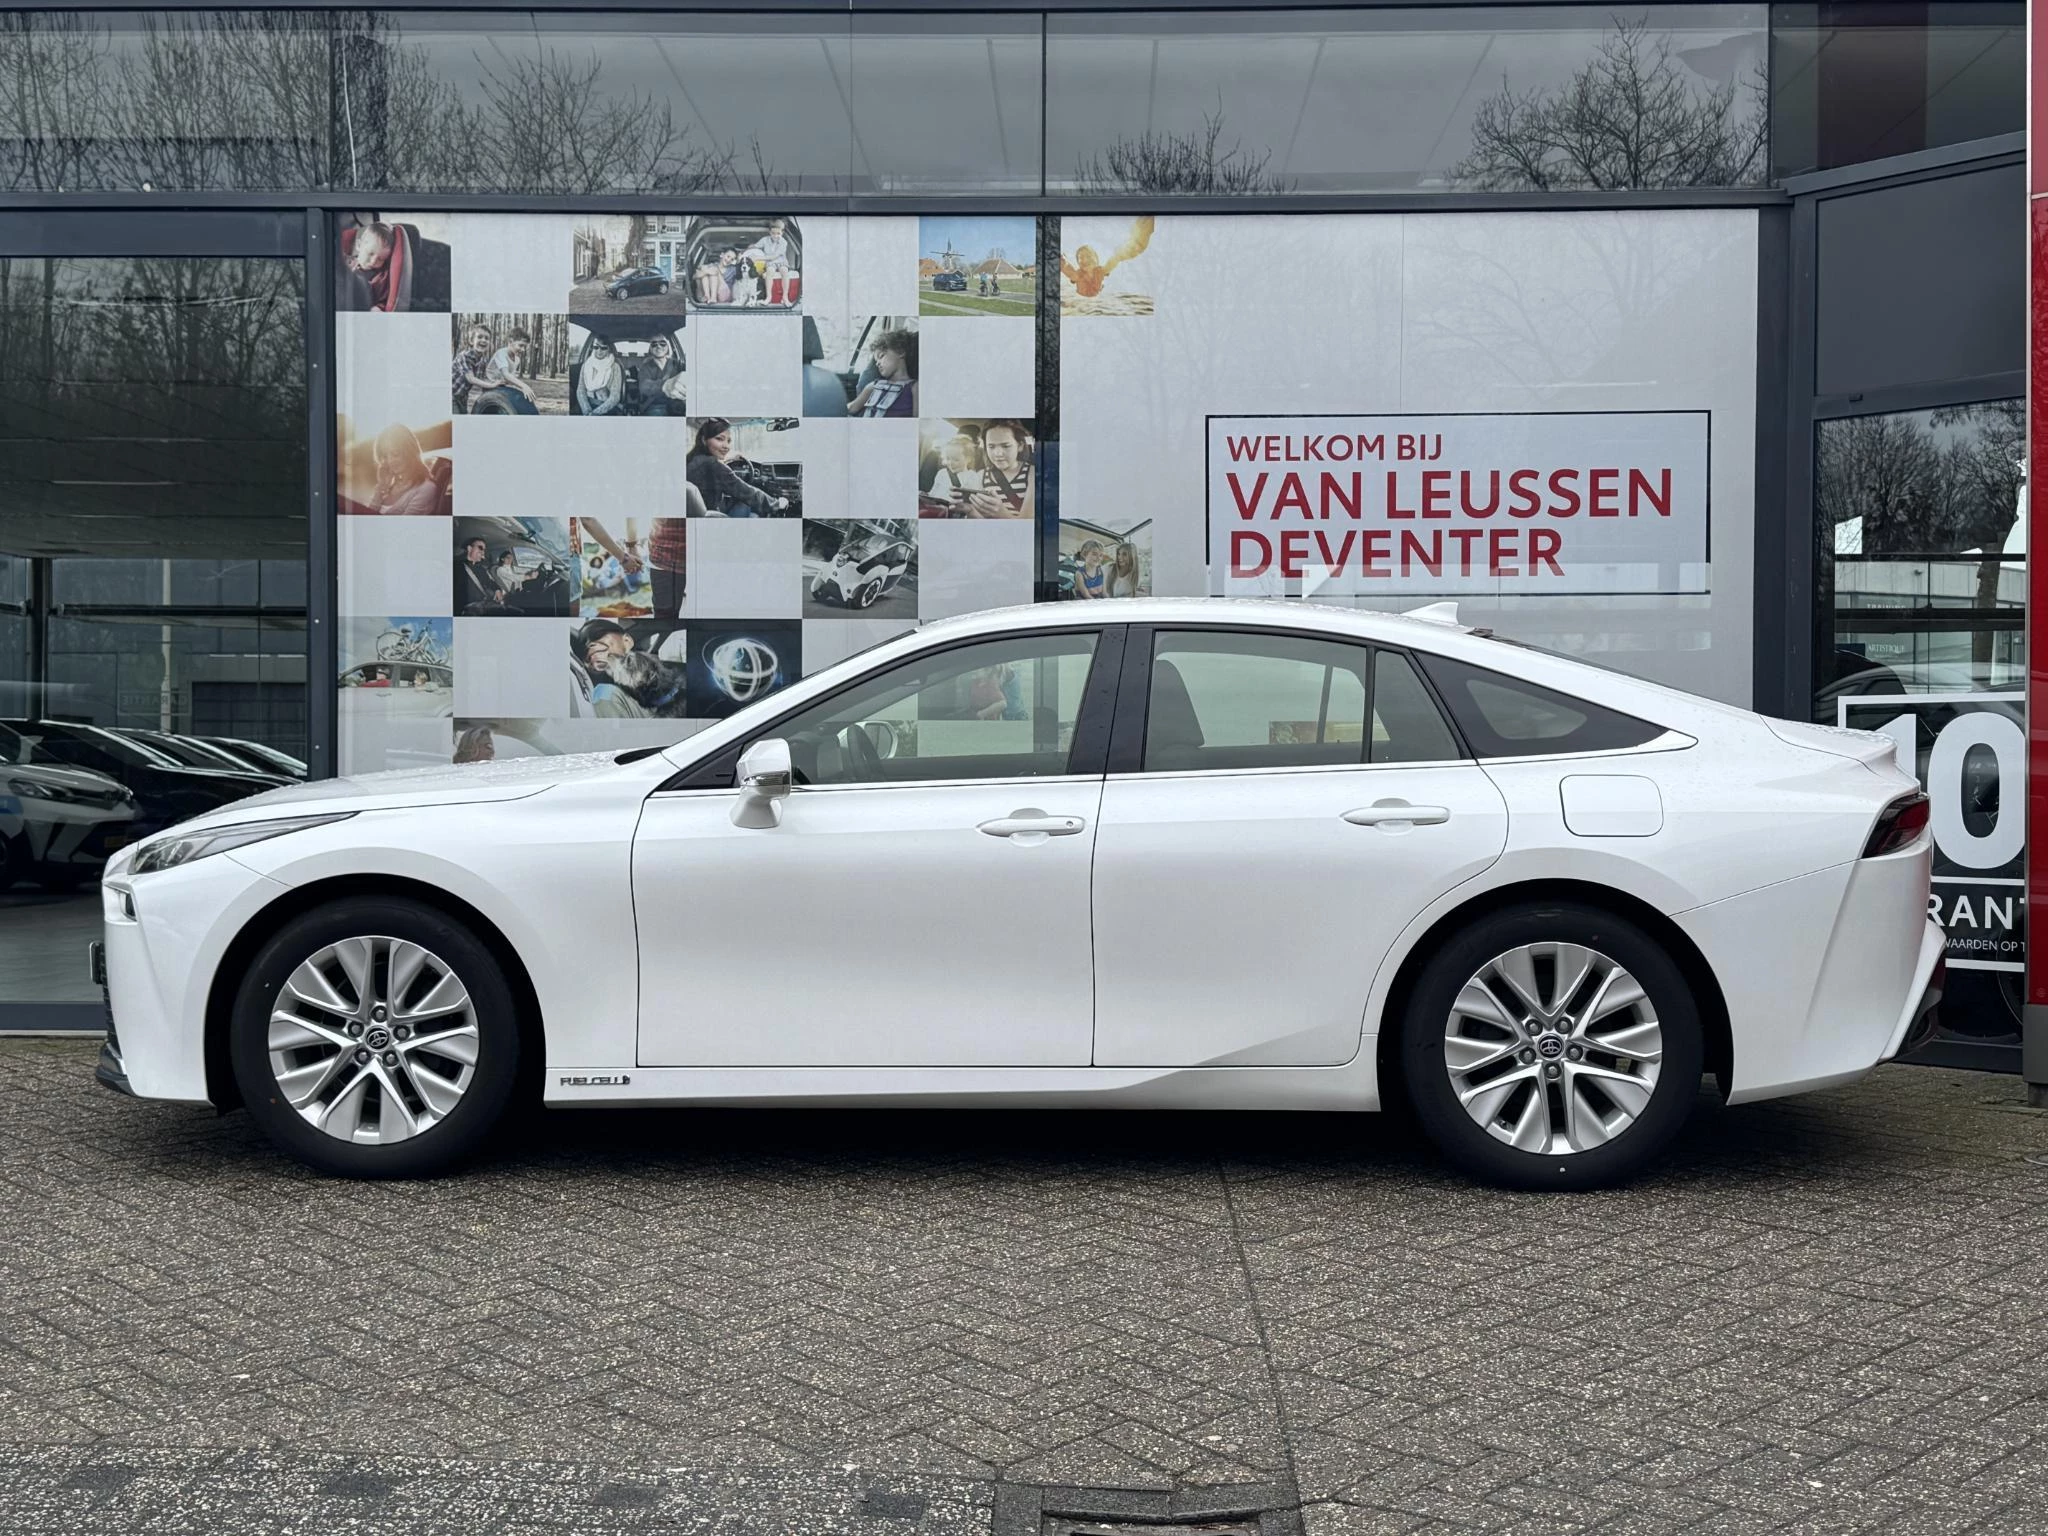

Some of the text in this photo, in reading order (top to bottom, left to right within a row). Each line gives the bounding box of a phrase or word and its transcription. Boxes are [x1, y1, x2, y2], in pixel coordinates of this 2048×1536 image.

[1226, 433, 1442, 462] WELKOM BIJ
[1226, 468, 1672, 520] VAN LEUSSEN
[1230, 528, 1566, 579] DEVENTER
[1927, 893, 2025, 930] RAN
[2001, 940, 2018, 952] OP
